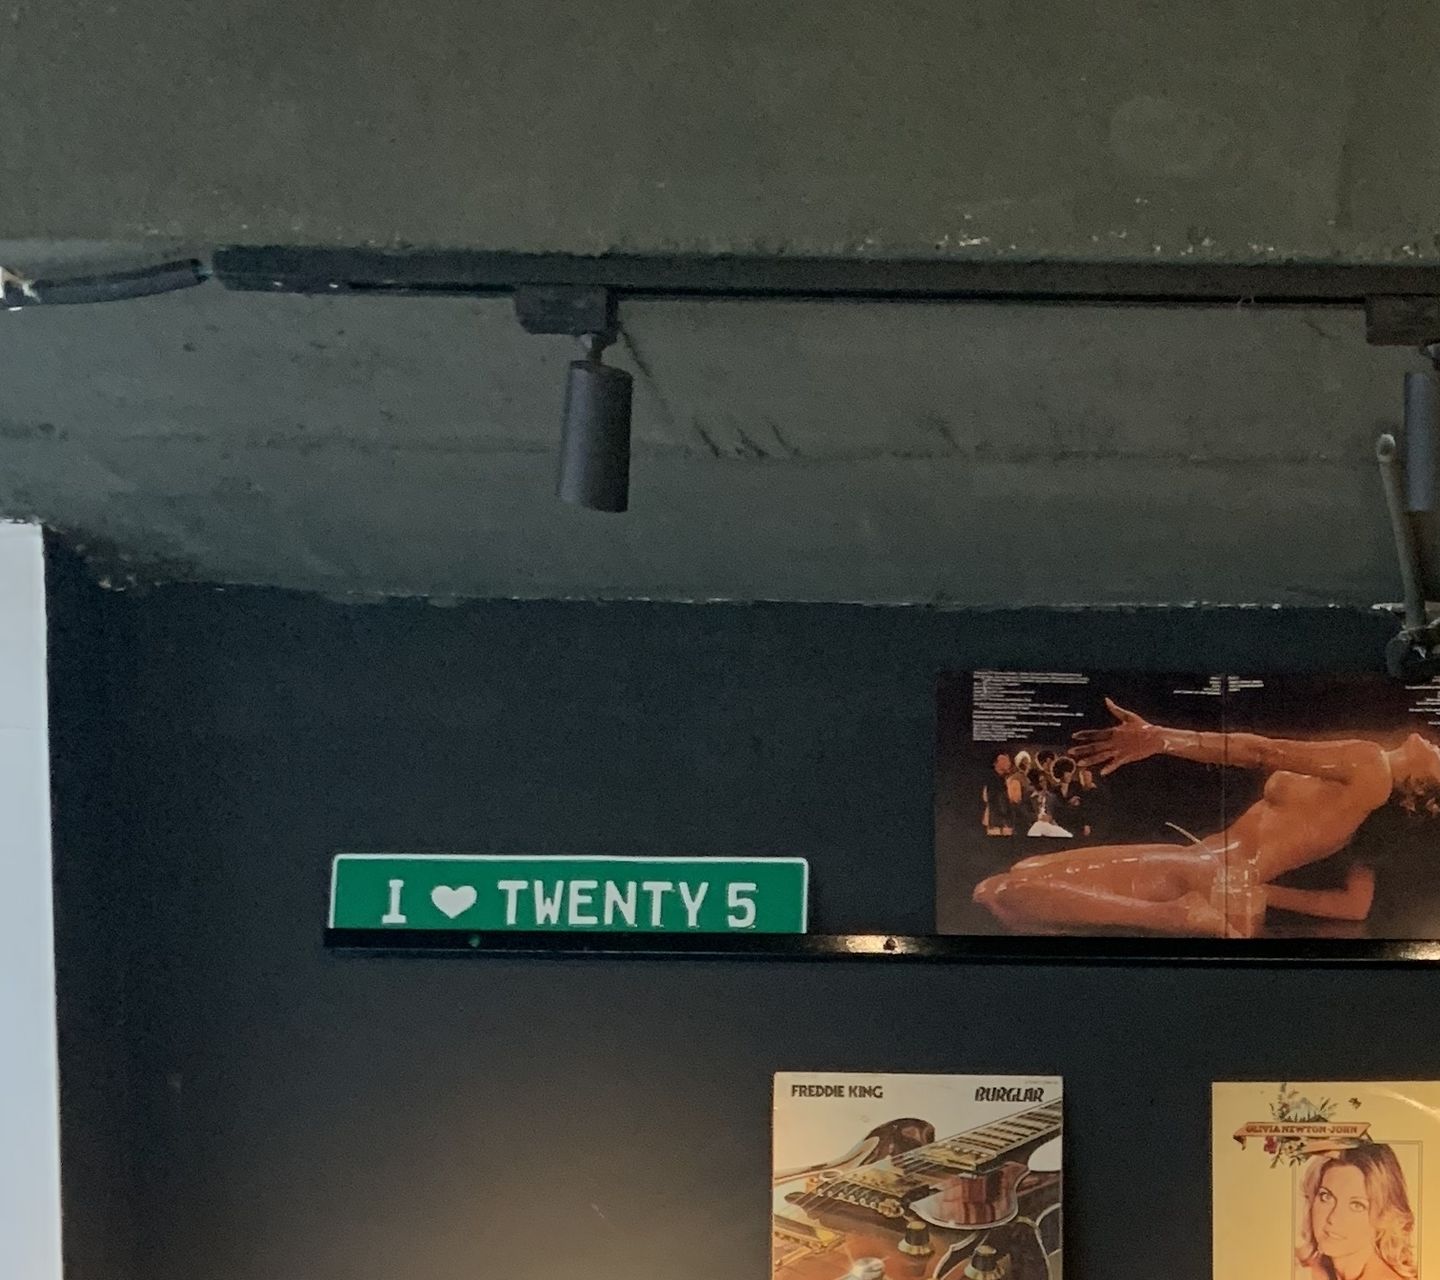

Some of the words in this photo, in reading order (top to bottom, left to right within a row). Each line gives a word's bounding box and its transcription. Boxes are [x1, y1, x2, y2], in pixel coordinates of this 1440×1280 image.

[381, 879, 407, 924] I
[497, 881, 709, 927] TWENTY
[726, 883, 757, 928] 5
[791, 1085, 844, 1098] FREDDIE
[849, 1086, 883, 1099] KING
[975, 1086, 1044, 1102] BURGLAR
[1246, 1125, 1279, 1133] OLIVIA
[1281, 1125, 1358, 1134] NEWTON-JOHN
